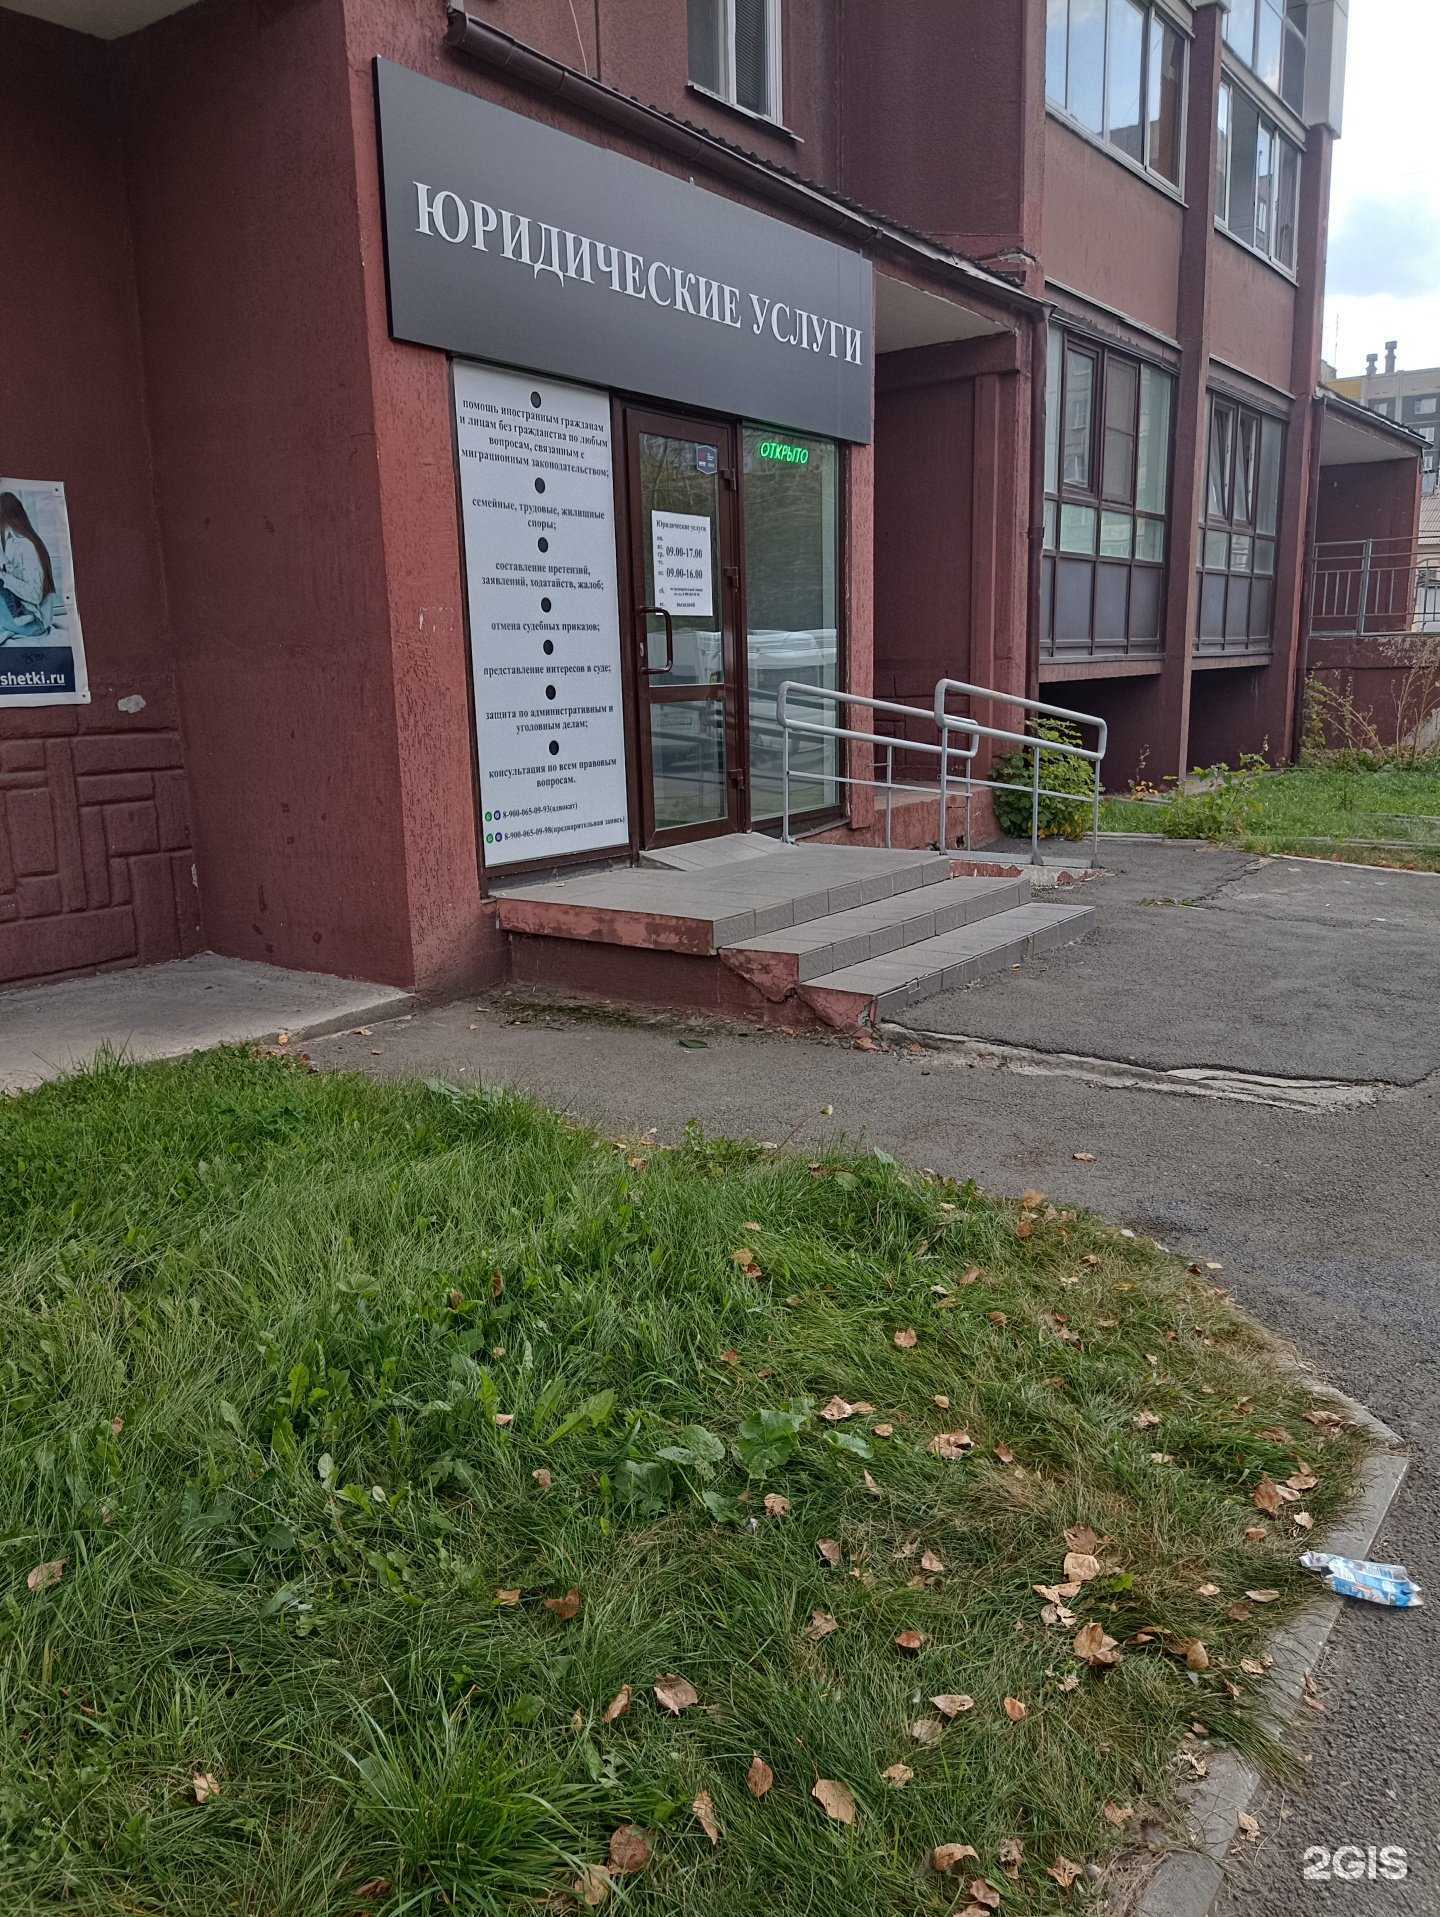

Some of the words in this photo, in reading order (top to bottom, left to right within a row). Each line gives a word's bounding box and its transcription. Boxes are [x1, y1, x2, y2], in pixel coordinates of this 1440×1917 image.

[413, 181, 741, 328] ЮРИДИЧЕСКИЕ
[748, 293, 863, 365] УСЛУГИ
[463, 400, 498, 413] помощь
[501, 407, 559, 424] иностранным
[561, 417, 603, 432] гражданам
[460, 416, 465, 424] и
[468, 418, 496, 428] лицам
[499, 420, 511, 431] без
[514, 427, 566, 440] гражданства
[569, 434, 578, 442] по
[580, 436, 608, 447] любым
[489, 437, 532, 452] вопросам,
[534, 443, 578, 457] связанным
[760, 442, 808, 464] ОТКРЫТО
[461, 448, 528, 464] миграционным
[532, 459, 609, 477] законодательством;
[472, 498, 517, 512] семейные,
[520, 504, 559, 517] трудовые,
[562, 508, 605, 519] жилищные
[528, 520, 557, 530] споры;
[666, 546, 702, 558] 09.00-17.00
[496, 562, 546, 573] составление
[549, 566, 590, 576] претензий,
[666, 568, 702, 579] 09.00-16.00
[482, 576, 527, 586] заявлений,
[531, 580, 576, 589] ходатайств,
[578, 580, 603, 591] жалоб;
[491, 622, 520, 631] отмена
[523, 621, 559, 633] судебных
[562, 623, 600, 634] приказов;
[484, 666, 543, 677] представление
[546, 664, 584, 674] интересов
[486, 710, 516, 720] защита
[519, 710, 528, 718] по
[531, 706, 607, 718] административным
[516, 722, 560, 735] уголовным
[562, 720, 588, 730] делам;
[489, 765, 545, 779] консультация
[548, 764, 557, 772] по
[559, 762, 577, 770] всем
[580, 758, 617, 771] правовым
[537, 776, 576, 789] вопросам.
